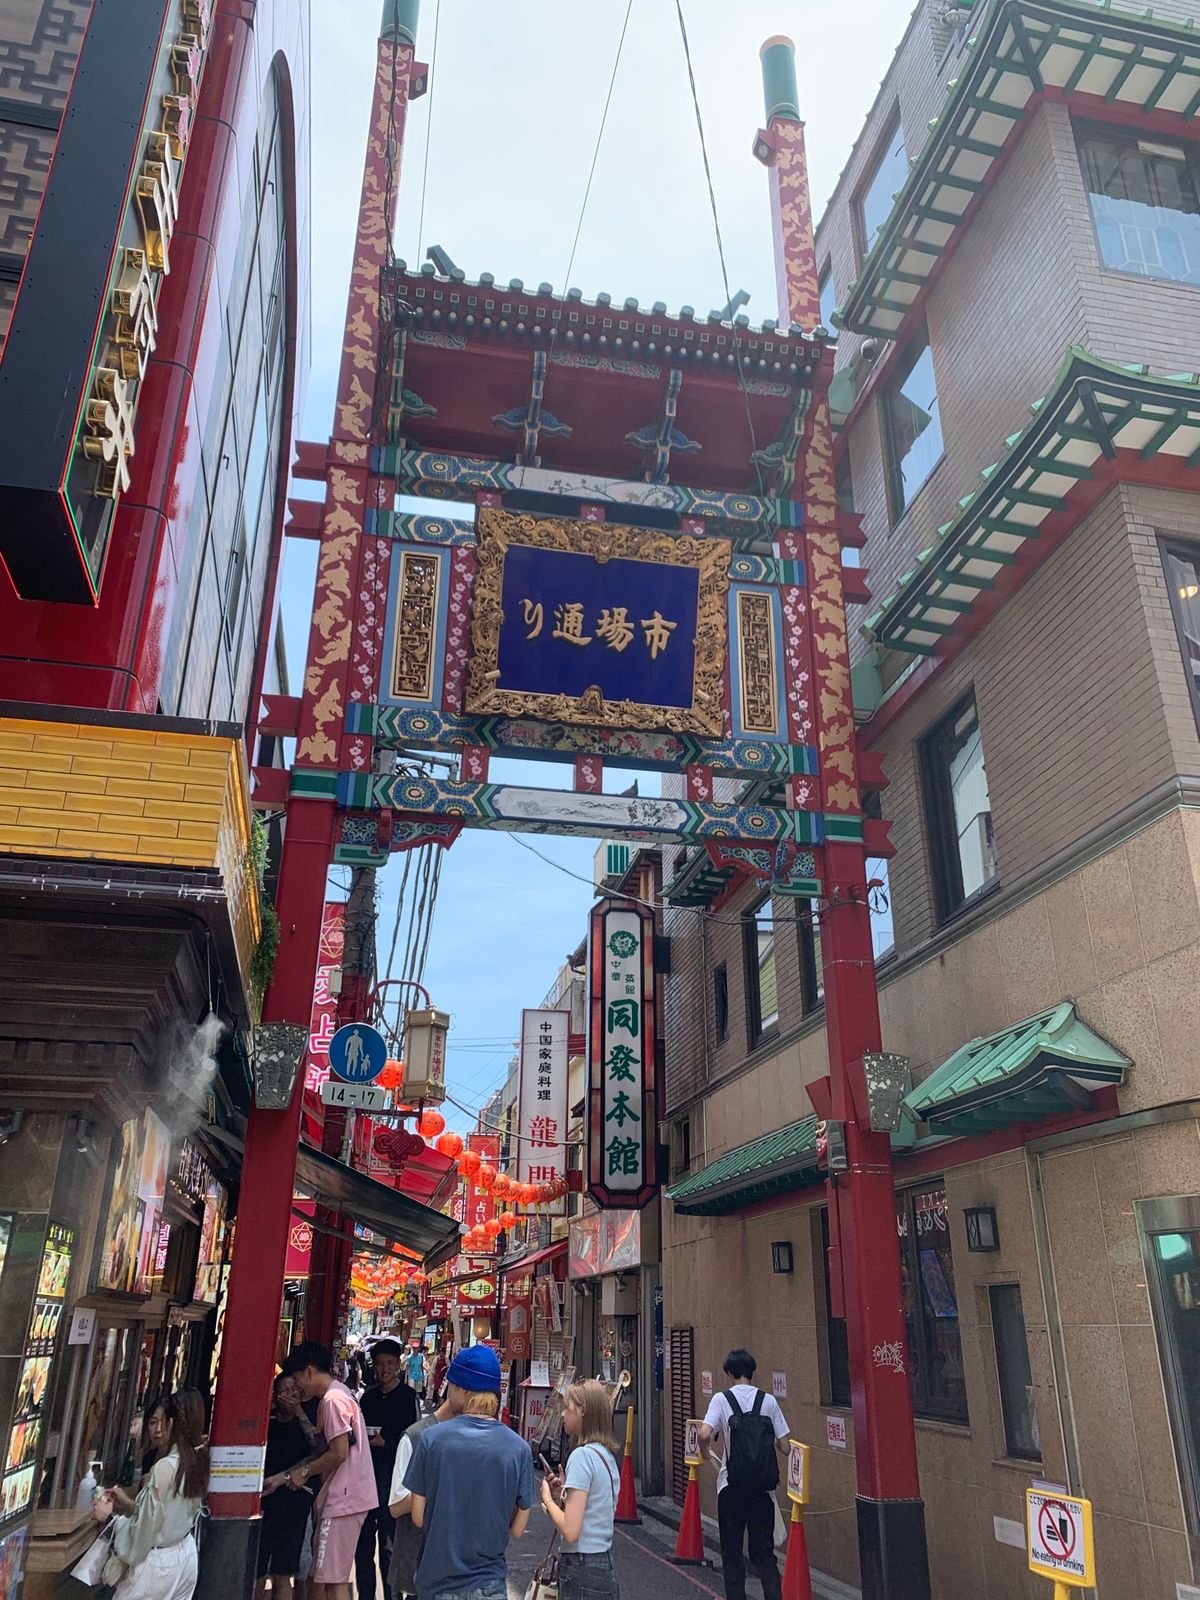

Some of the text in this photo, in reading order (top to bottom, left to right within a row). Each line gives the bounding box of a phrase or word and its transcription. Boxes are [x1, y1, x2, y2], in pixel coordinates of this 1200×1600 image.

[519, 599, 677, 660] 市場通り
[537, 1021, 552, 1101] 中国家庭料理
[330, 1087, 375, 1105] 14-17
[605, 998, 641, 1176] 同發本館
[463, 1283, 491, 1295] 手相
[1032, 1547, 1040, 1561] No
